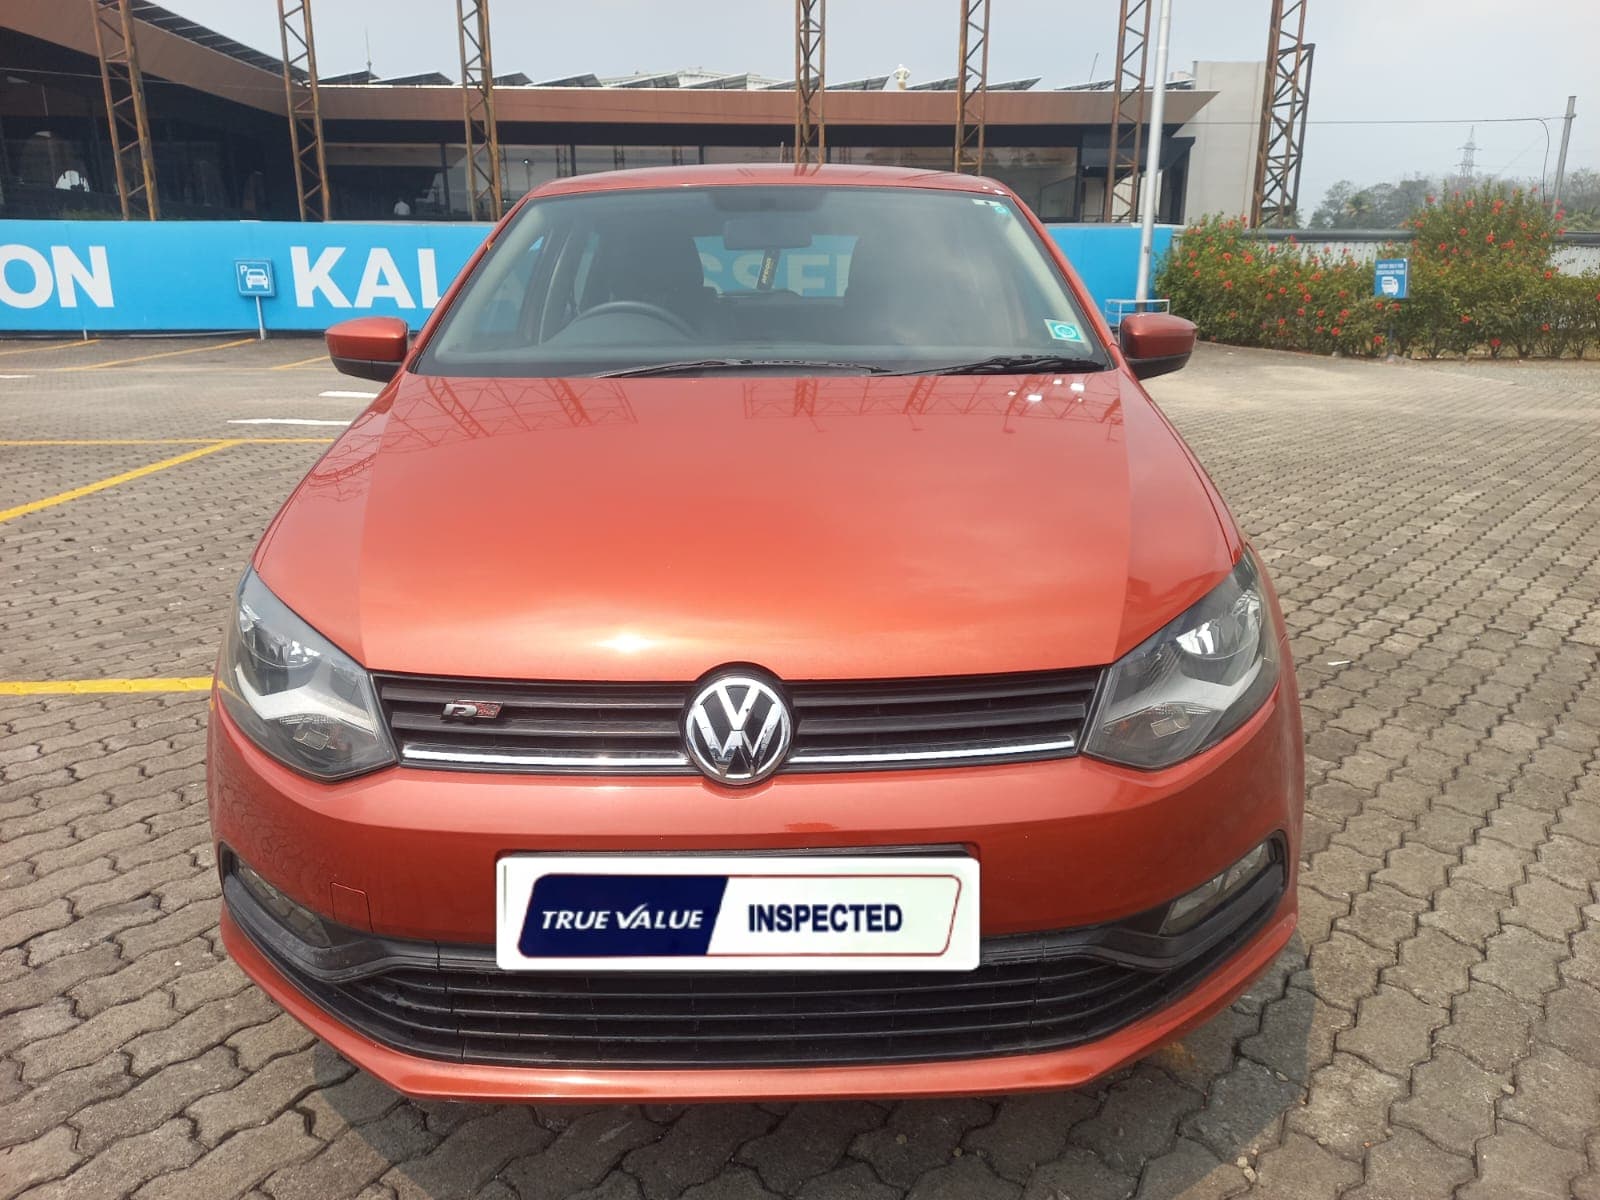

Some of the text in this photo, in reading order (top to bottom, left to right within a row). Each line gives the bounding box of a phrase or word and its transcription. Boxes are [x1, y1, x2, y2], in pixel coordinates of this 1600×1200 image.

[542, 903, 903, 933] TRUE VALUE INSPECTED
